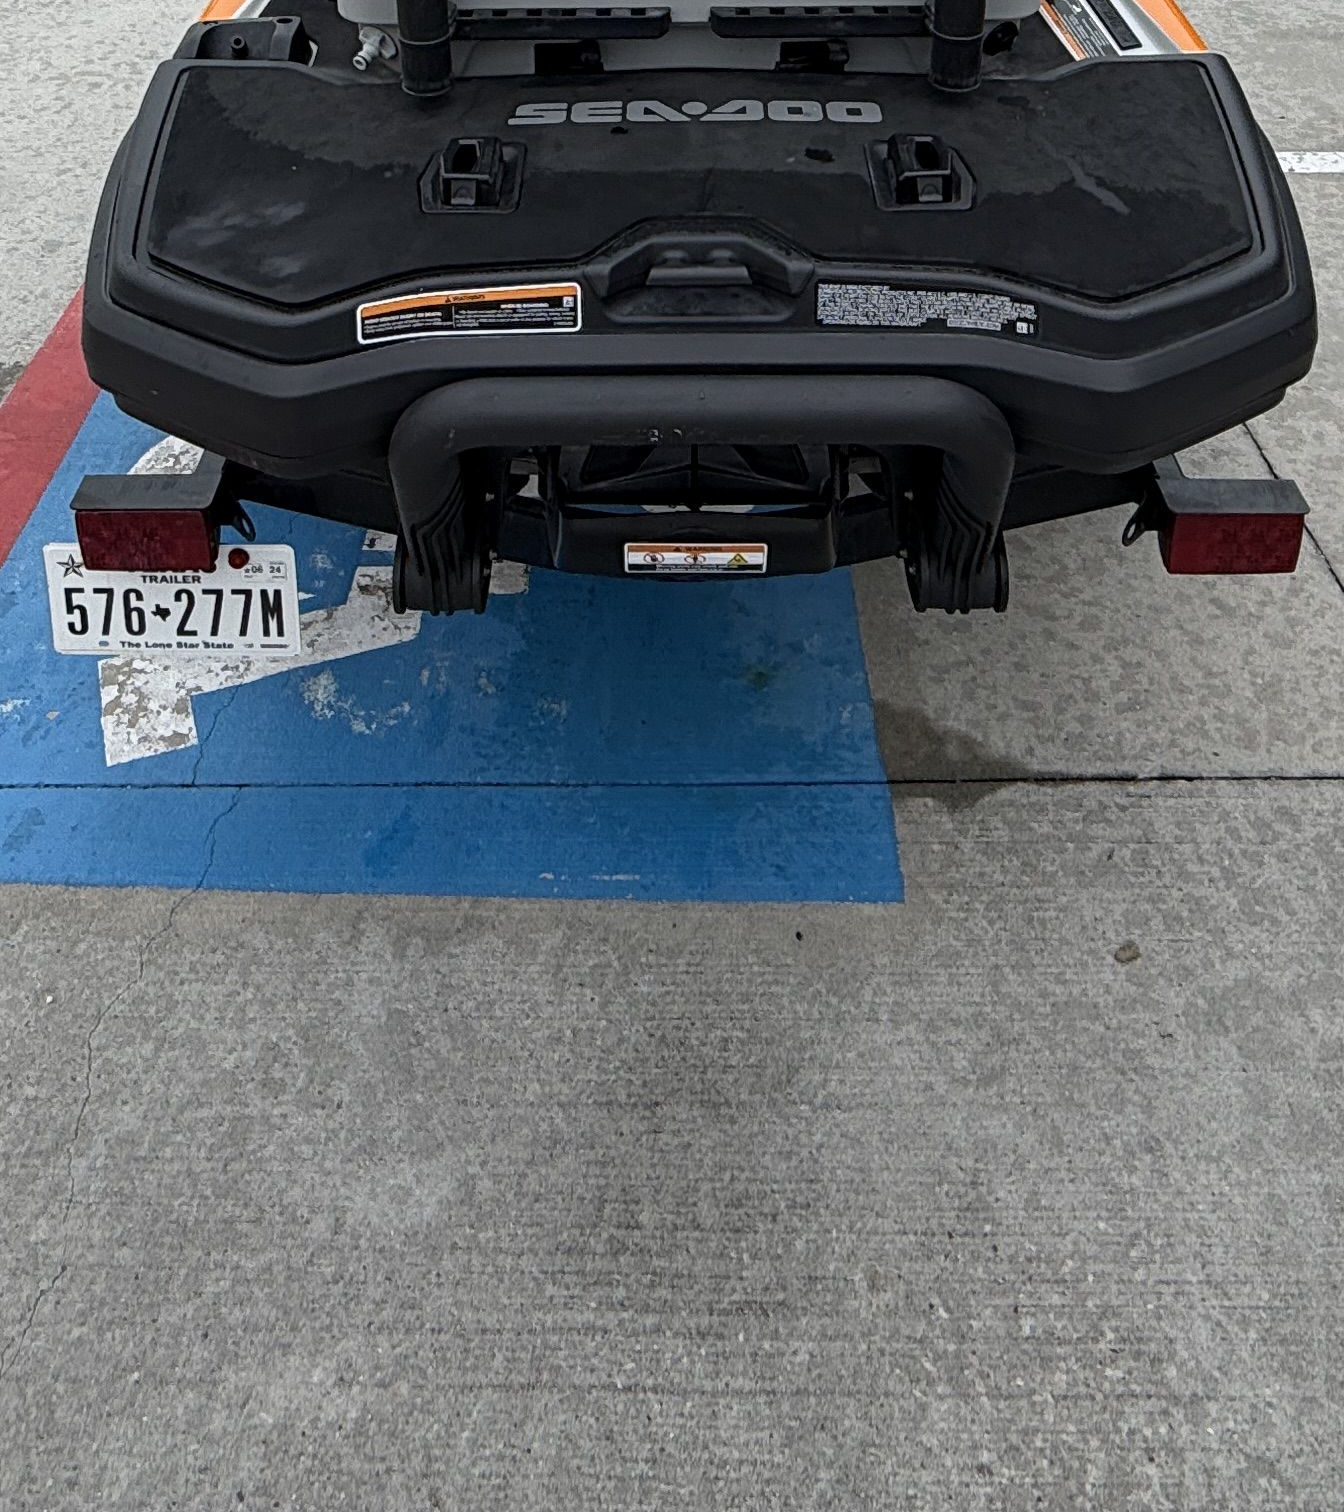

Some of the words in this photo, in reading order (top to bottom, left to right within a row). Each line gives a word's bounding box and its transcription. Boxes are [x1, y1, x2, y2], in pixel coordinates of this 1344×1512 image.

[140, 574, 202, 585] TRAILER
[64, 587, 147, 636] 576
[173, 588, 286, 638] 277M
[119, 641, 140, 649] The
[145, 641, 172, 650] Lone
[176, 641, 199, 649] Star
[203, 641, 234, 649] State
